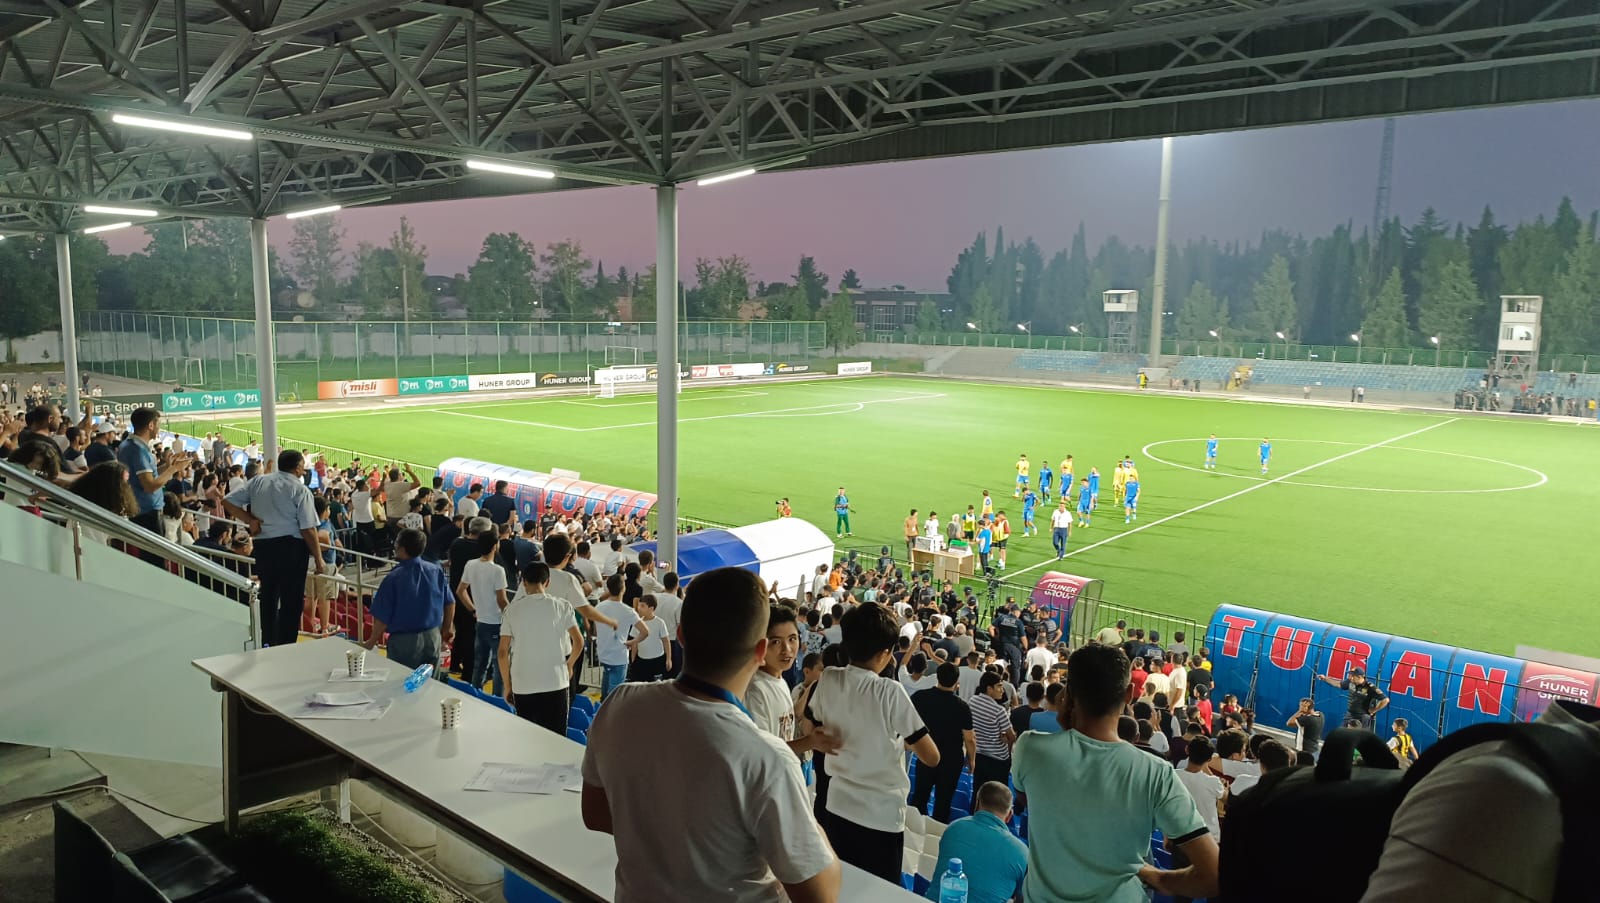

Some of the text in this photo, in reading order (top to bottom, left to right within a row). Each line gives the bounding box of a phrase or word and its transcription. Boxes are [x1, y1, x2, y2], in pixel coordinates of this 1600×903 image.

[350, 381, 377, 391] misli
[180, 397, 192, 406] PFL
[213, 395, 226, 404] PFL
[246, 394, 258, 403] PFL
[1047, 582, 1078, 594] HUNER
[1222, 614, 1508, 716] TURAN
[1540, 681, 1589, 697] HUNER
